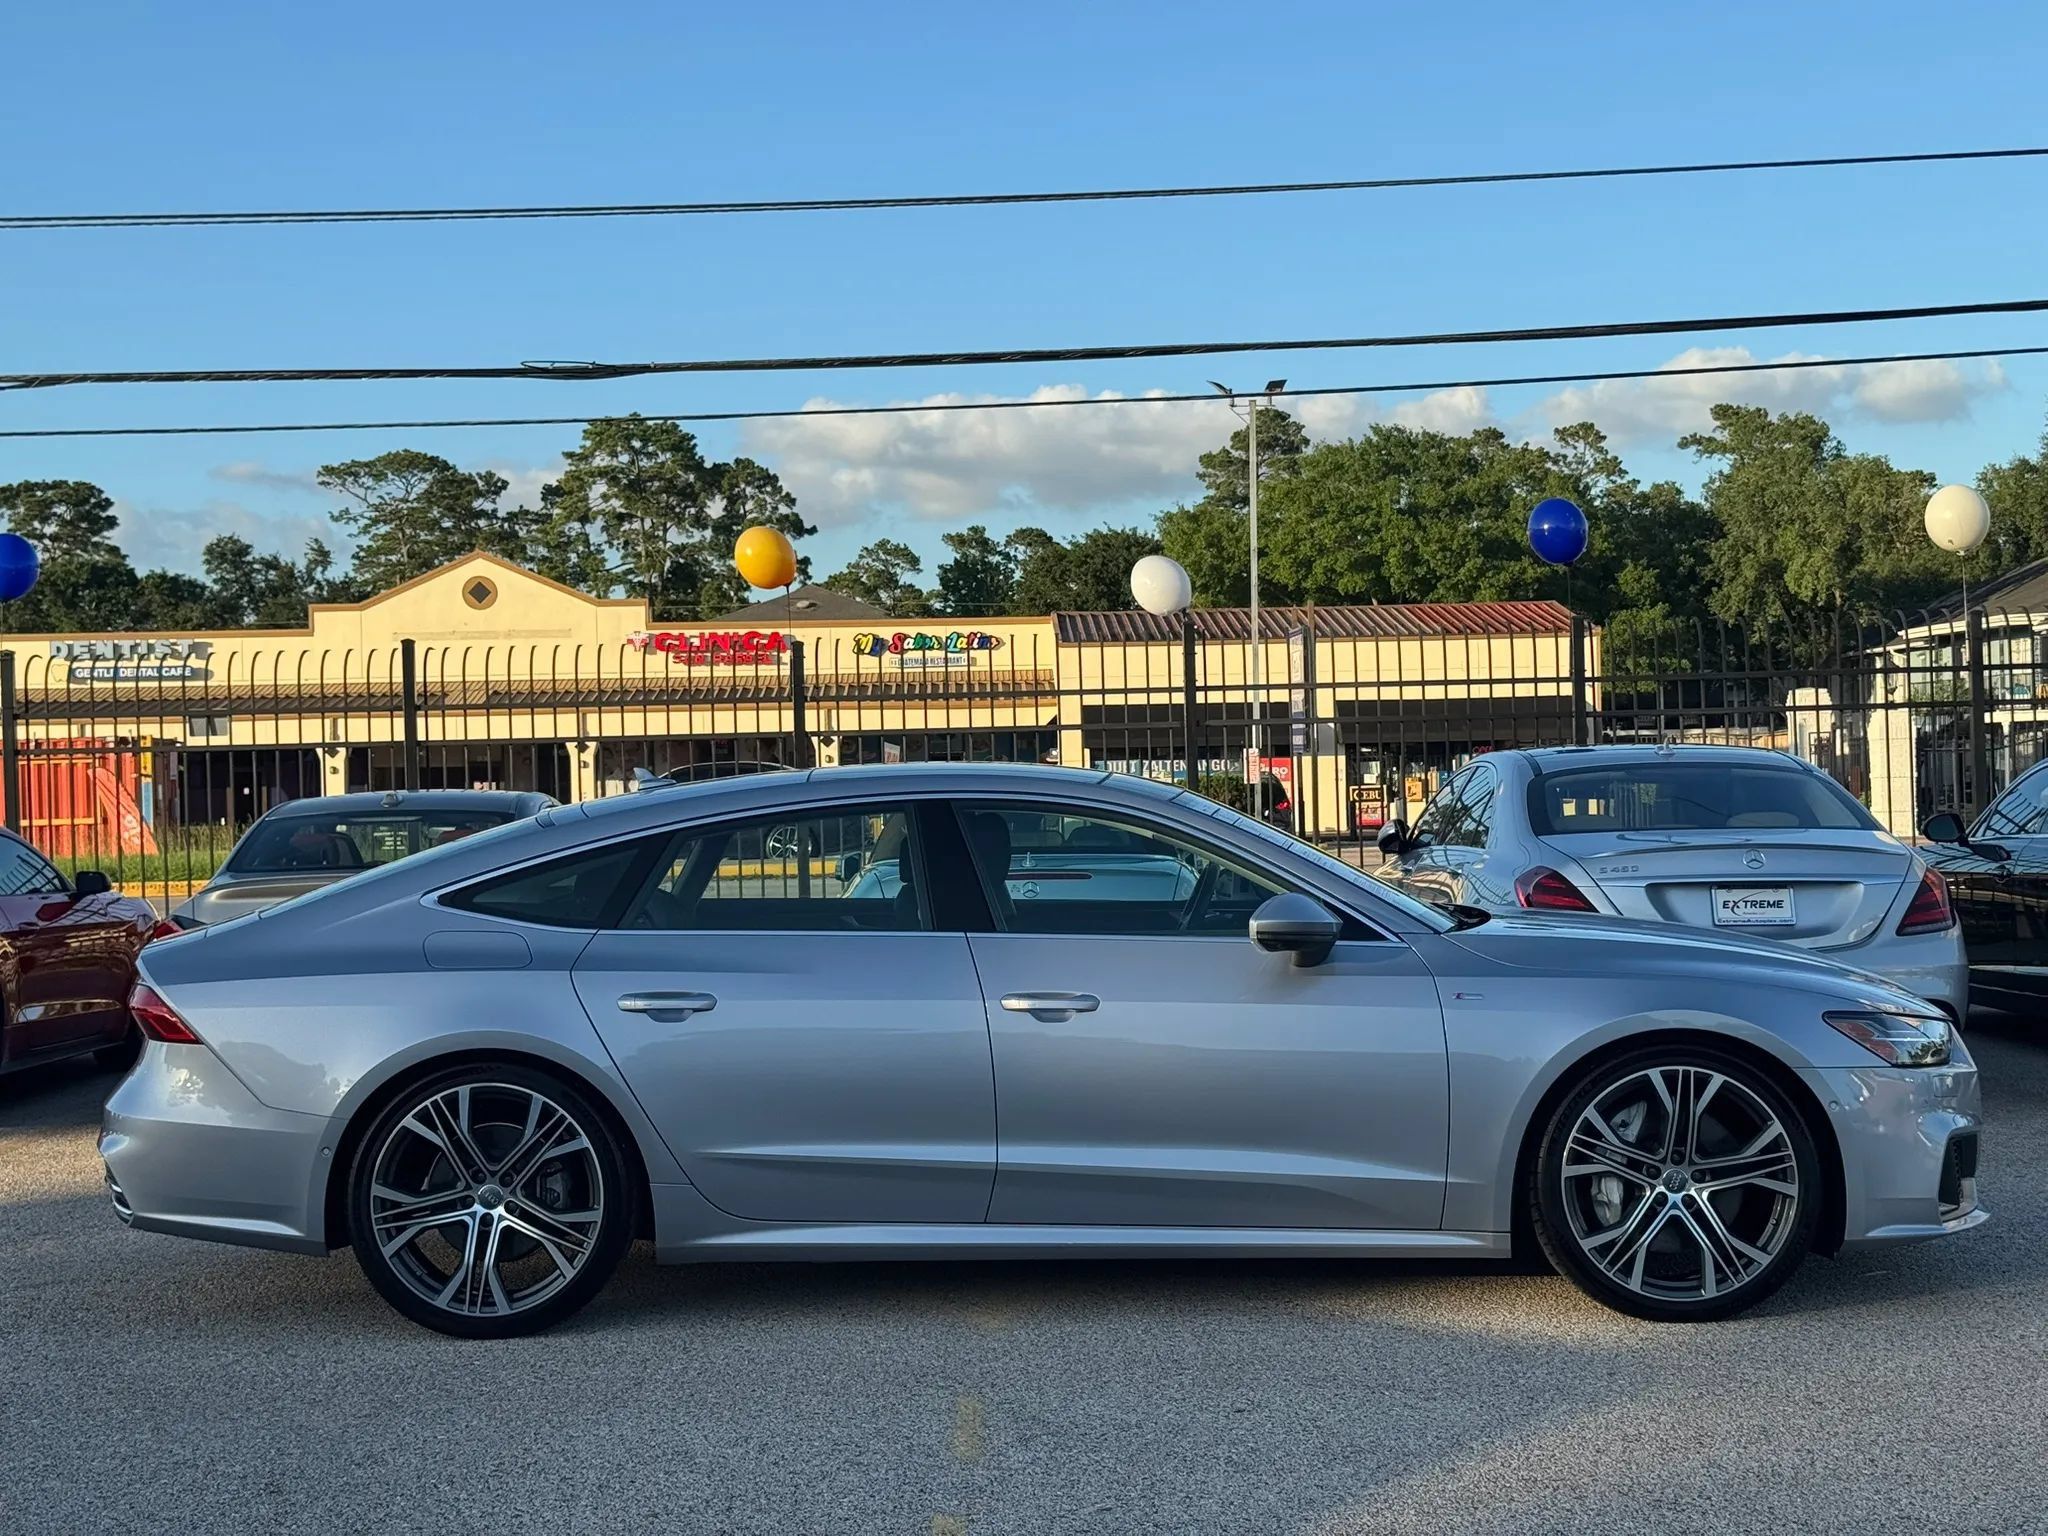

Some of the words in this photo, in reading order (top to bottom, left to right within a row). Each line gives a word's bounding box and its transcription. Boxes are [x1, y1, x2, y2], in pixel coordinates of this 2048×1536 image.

[50, 638, 195, 659] DENTIST
[119, 667, 159, 678] DENTAL
[1722, 898, 1785, 911] EXTREME
